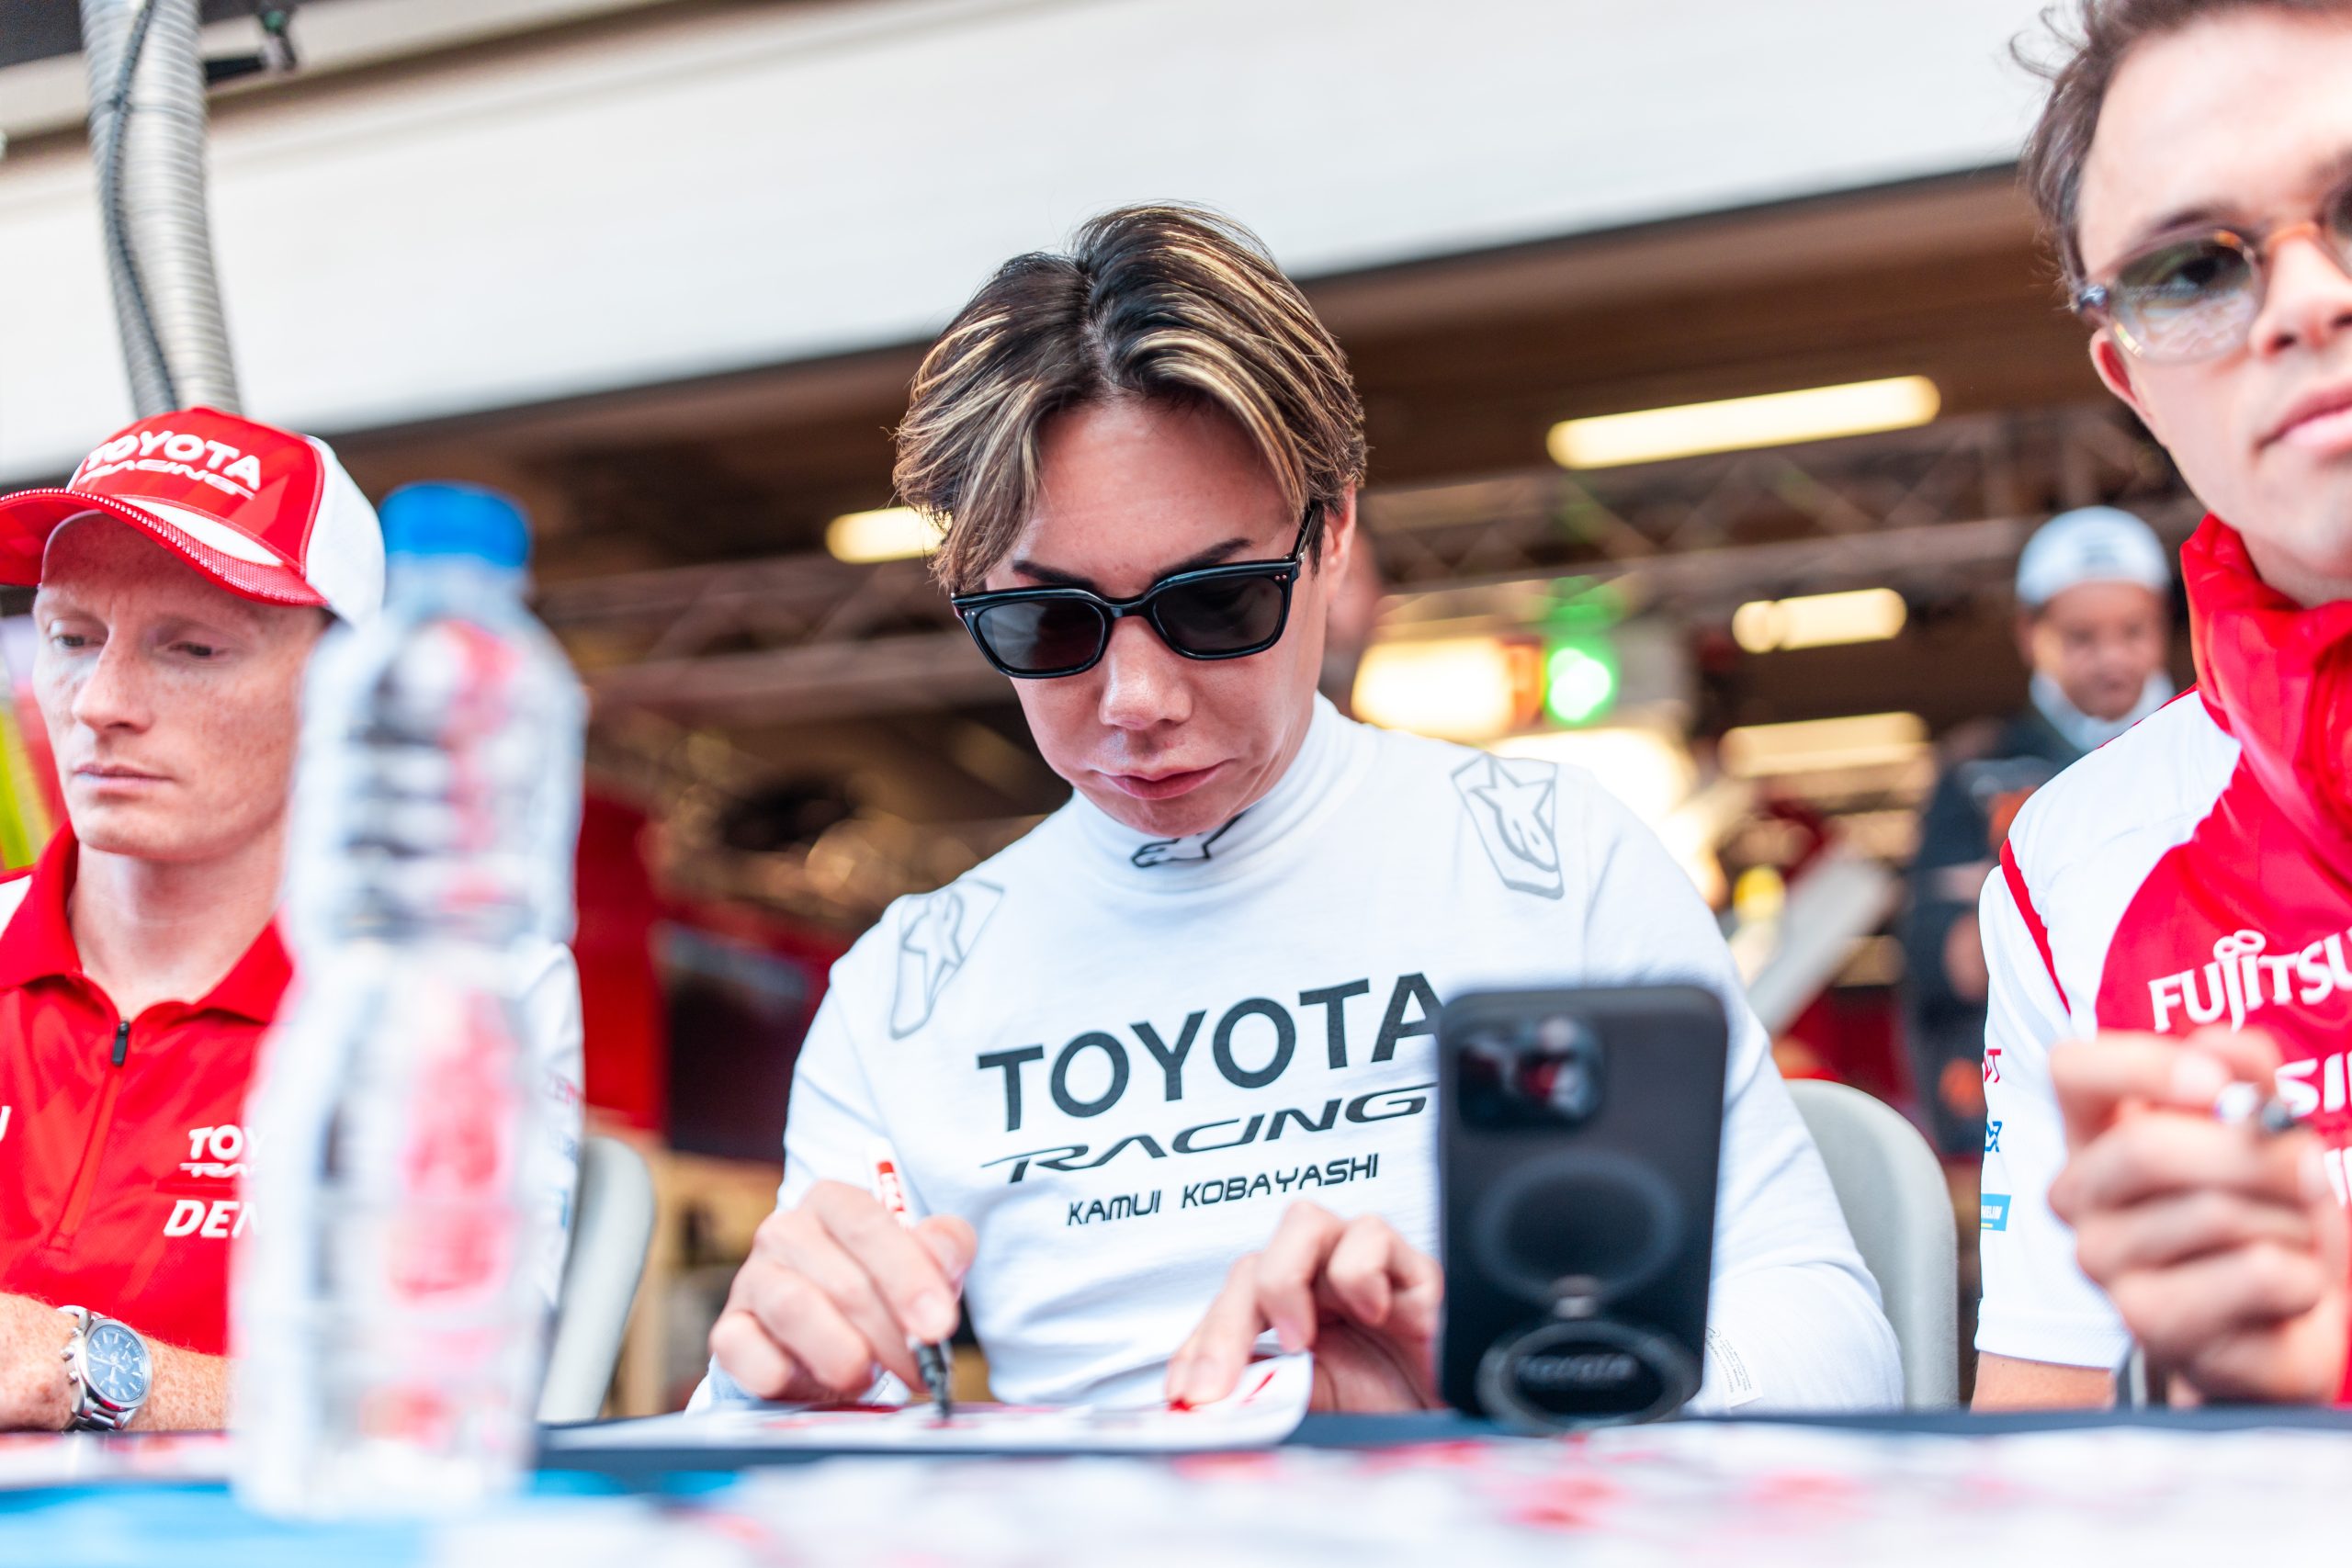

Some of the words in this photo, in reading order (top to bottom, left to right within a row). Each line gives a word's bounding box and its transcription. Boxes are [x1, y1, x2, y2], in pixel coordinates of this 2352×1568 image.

[84, 430, 261, 491] TOYOTA
[977, 971, 1445, 1133] TOYOTA
[979, 1081, 1440, 1183] RACING
[1066, 1189, 1162, 1227] KAMUI
[1182, 1153, 1380, 1210] KOBAYASHI
